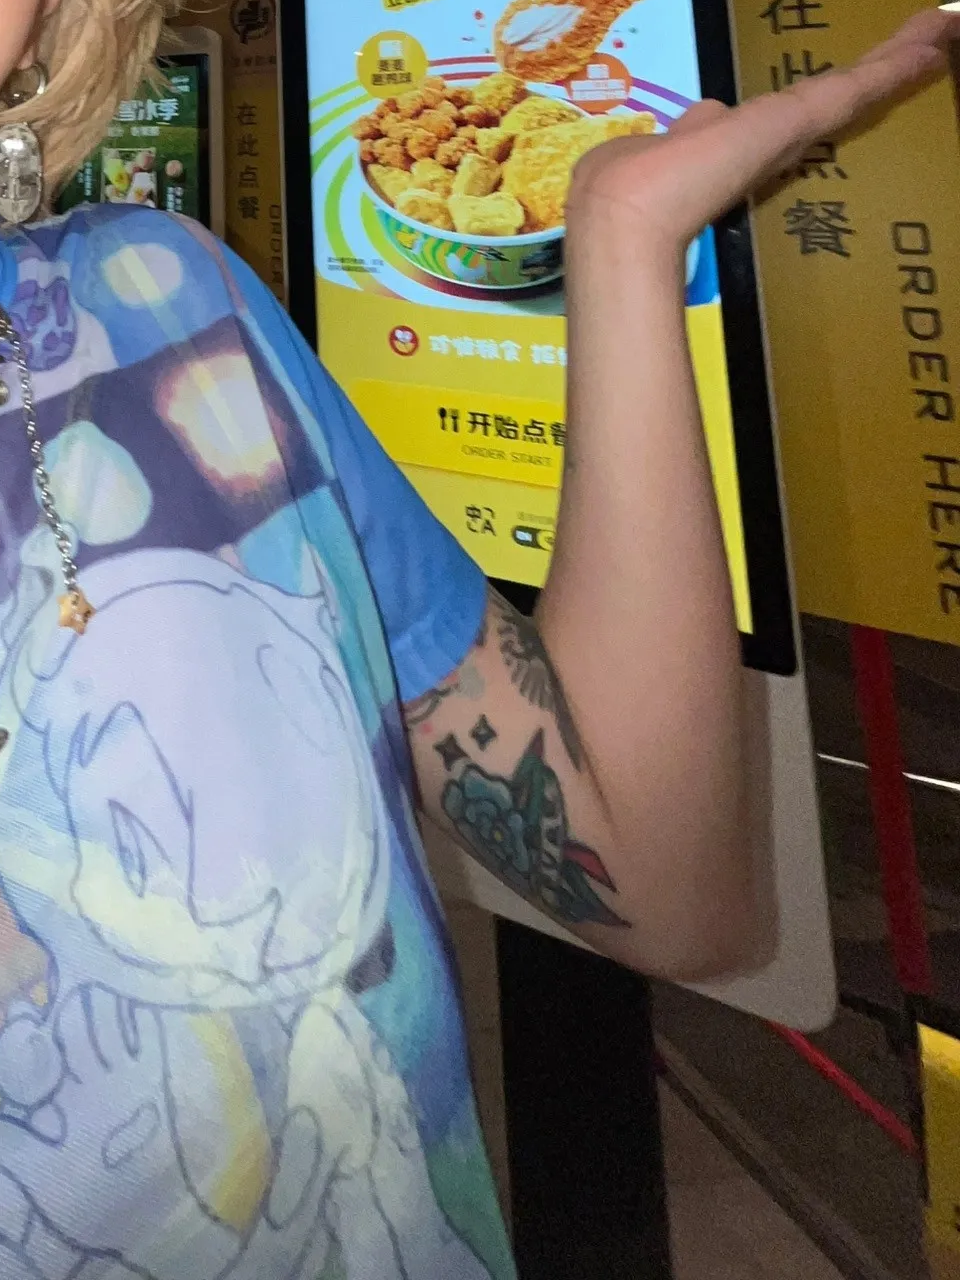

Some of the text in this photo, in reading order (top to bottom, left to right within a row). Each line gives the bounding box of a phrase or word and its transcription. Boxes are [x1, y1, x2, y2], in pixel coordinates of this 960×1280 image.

[235, 100, 260, 221] 在此点餐
[892, 220, 955, 422] ORDER
[460, 443, 554, 468] ORDER START
